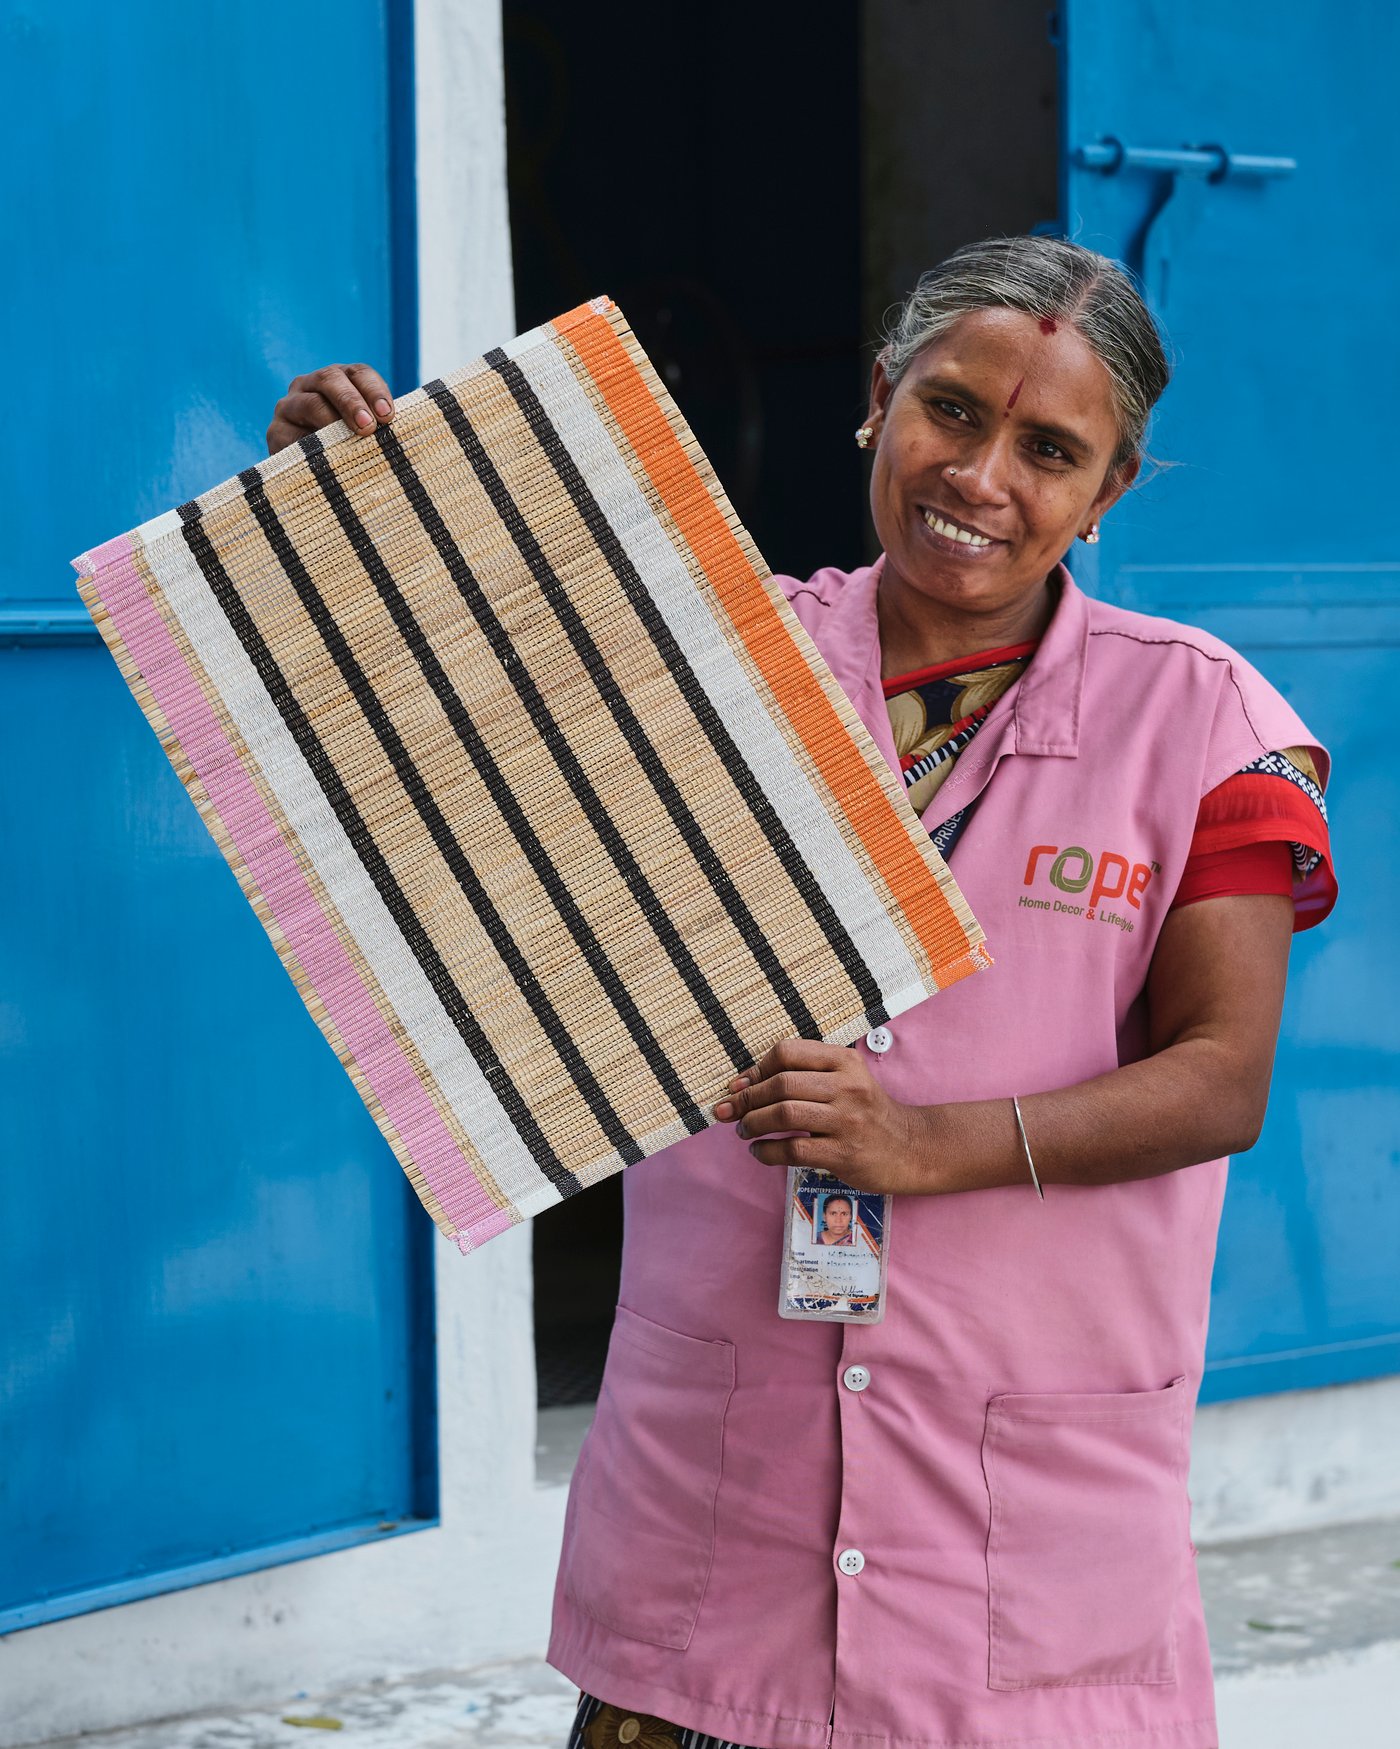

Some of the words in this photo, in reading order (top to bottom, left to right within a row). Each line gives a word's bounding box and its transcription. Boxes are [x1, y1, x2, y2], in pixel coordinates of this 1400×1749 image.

[1023, 845, 1153, 910] rope
[1018, 895, 1051, 910] Home
[1053, 901, 1085, 916] Decor
[1085, 907, 1096, 921] &
